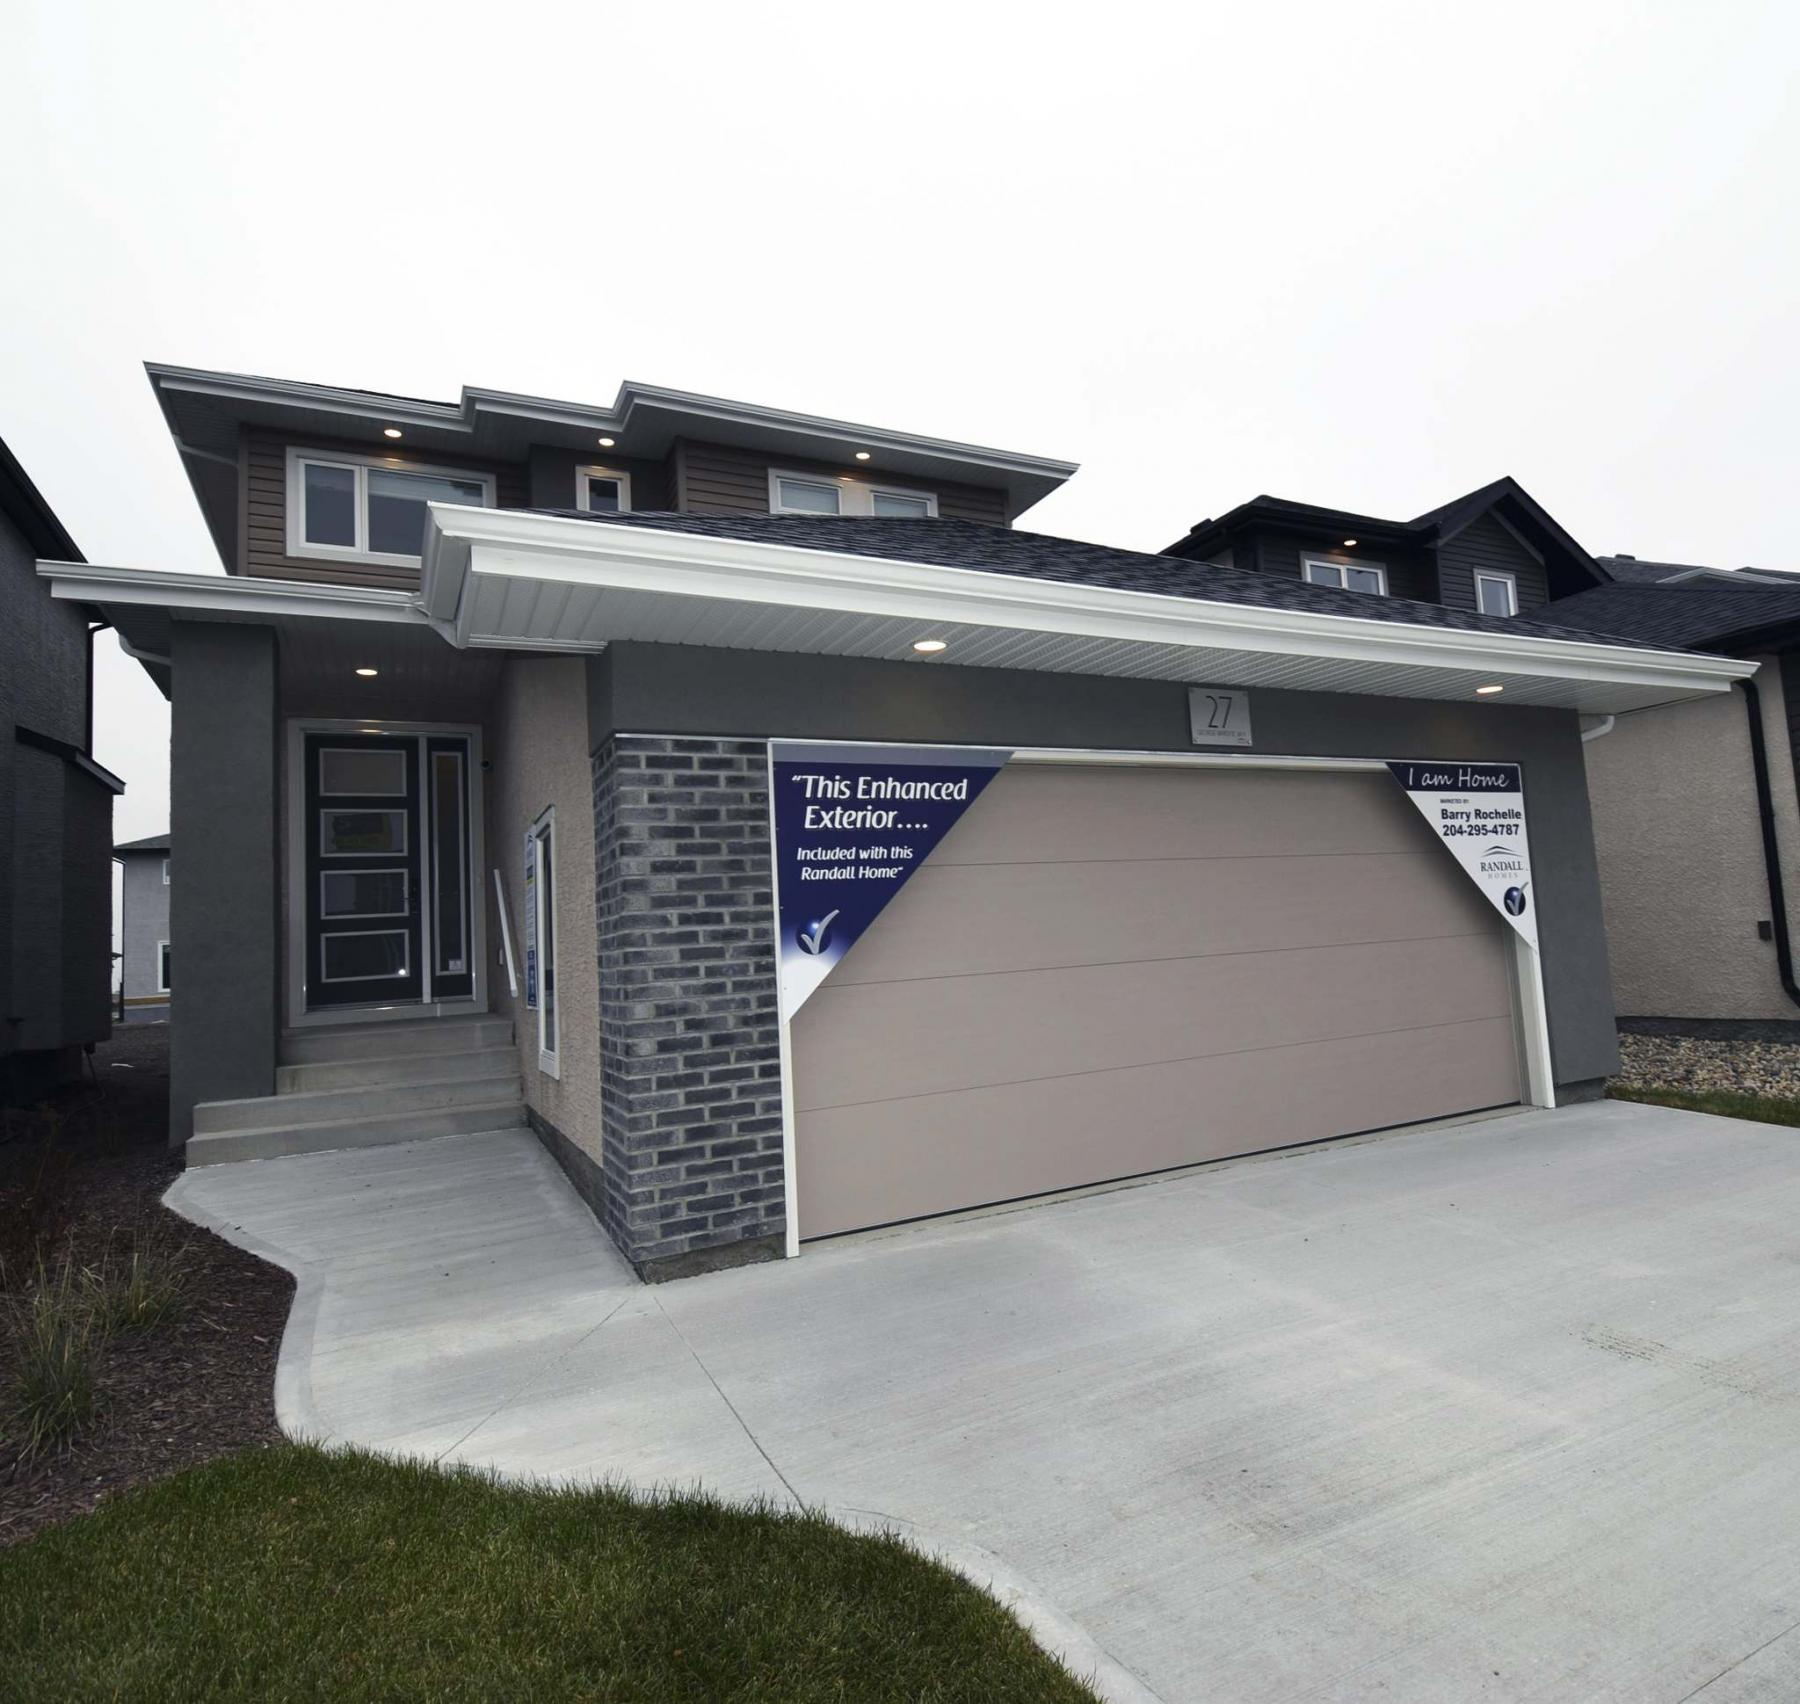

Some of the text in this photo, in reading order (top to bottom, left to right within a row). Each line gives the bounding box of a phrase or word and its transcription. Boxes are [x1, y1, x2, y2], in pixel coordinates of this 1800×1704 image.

[1205, 695, 1233, 729] 27
[1408, 768, 1510, 788] I am Home
[856, 776, 968, 800] Enhanced
[804, 805, 928, 829] Exterior....
[1441, 809, 1522, 822] Barry Rochelle
[1442, 824, 1520, 836] 204-295-4787
[797, 846, 914, 861] Included with this
[800, 867, 856, 881] Randall
[1480, 861, 1524, 872] RANDALL
